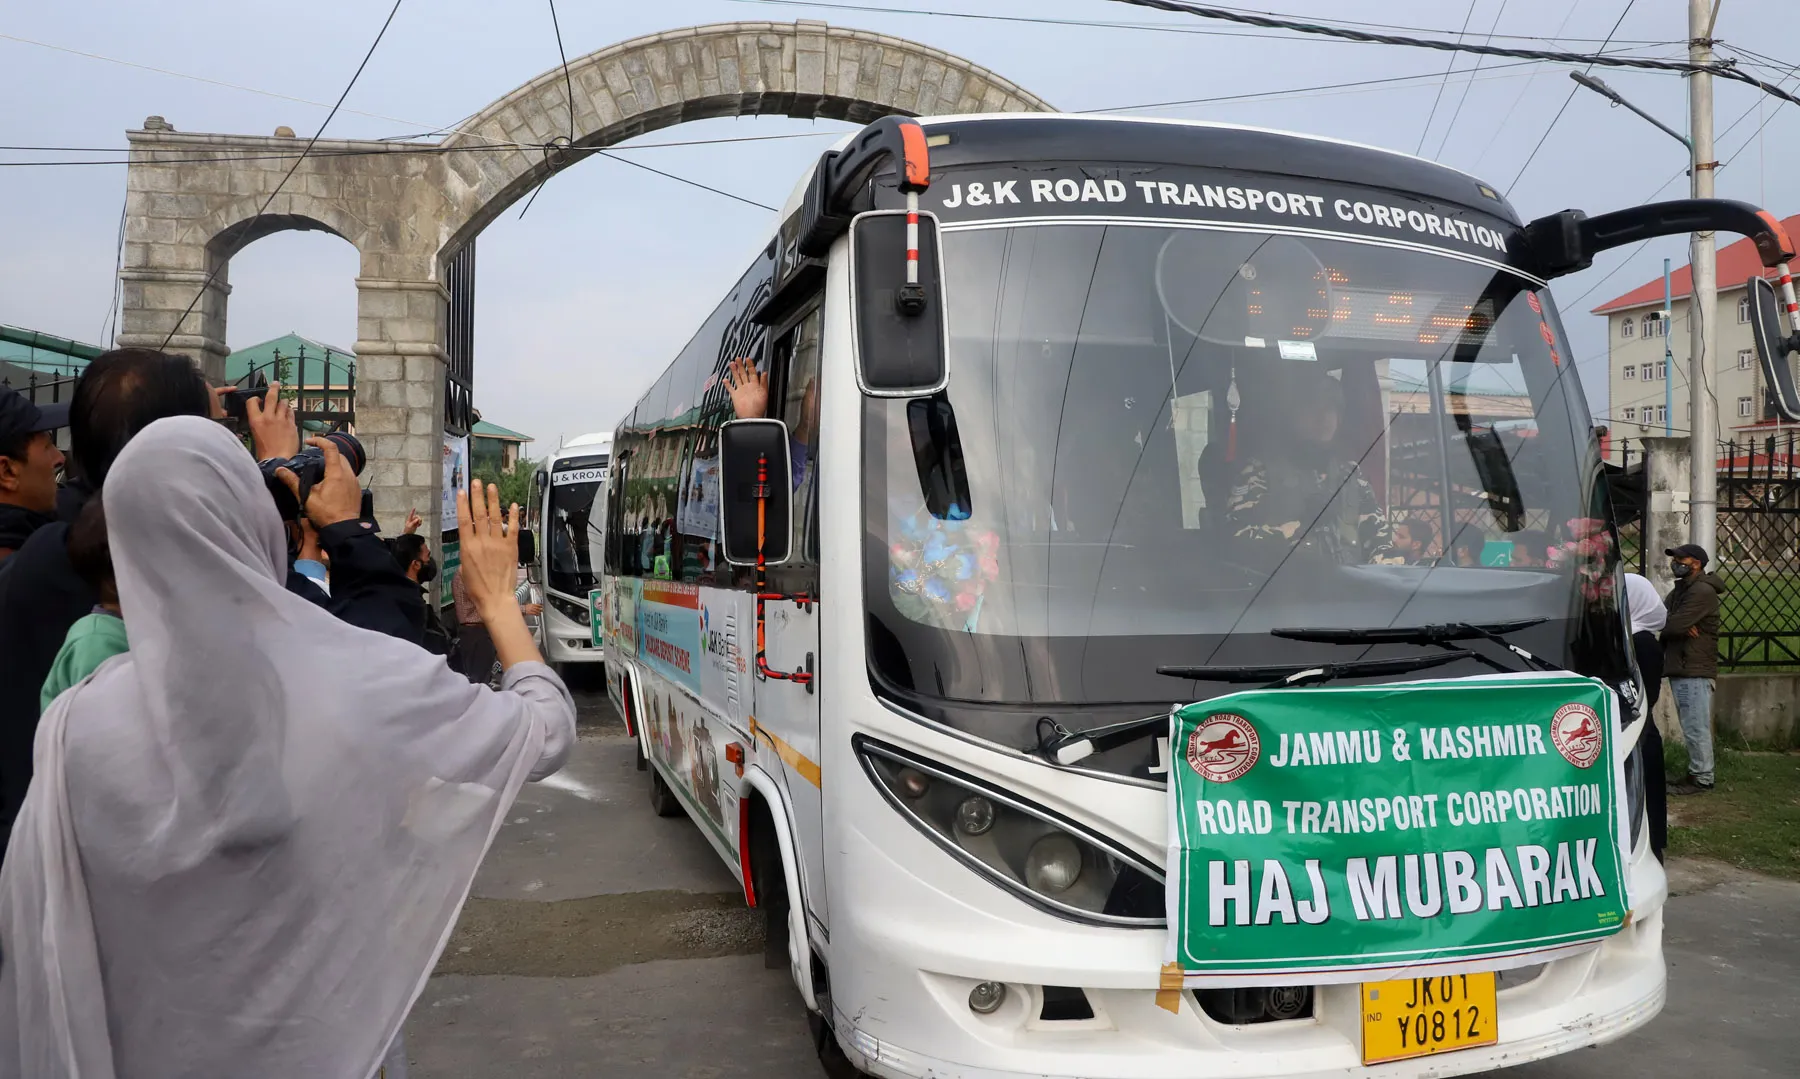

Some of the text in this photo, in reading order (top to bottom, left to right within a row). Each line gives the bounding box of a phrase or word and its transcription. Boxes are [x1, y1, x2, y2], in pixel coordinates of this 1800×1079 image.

[942, 178, 1509, 254] J&K ROAD TRANSPORT CORPORATION
[561, 473, 570, 482] &
[1269, 722, 1548, 768] JAMMU & KASHMIR
[1196, 783, 1602, 836] ROAD TRANSPORT CORPORATION
[1208, 836, 1607, 927] HAJ MUBARAK
[1406, 973, 1468, 1008] JK01
[1366, 1011, 1383, 1023] IND
[1397, 1005, 1480, 1048] Y0812
